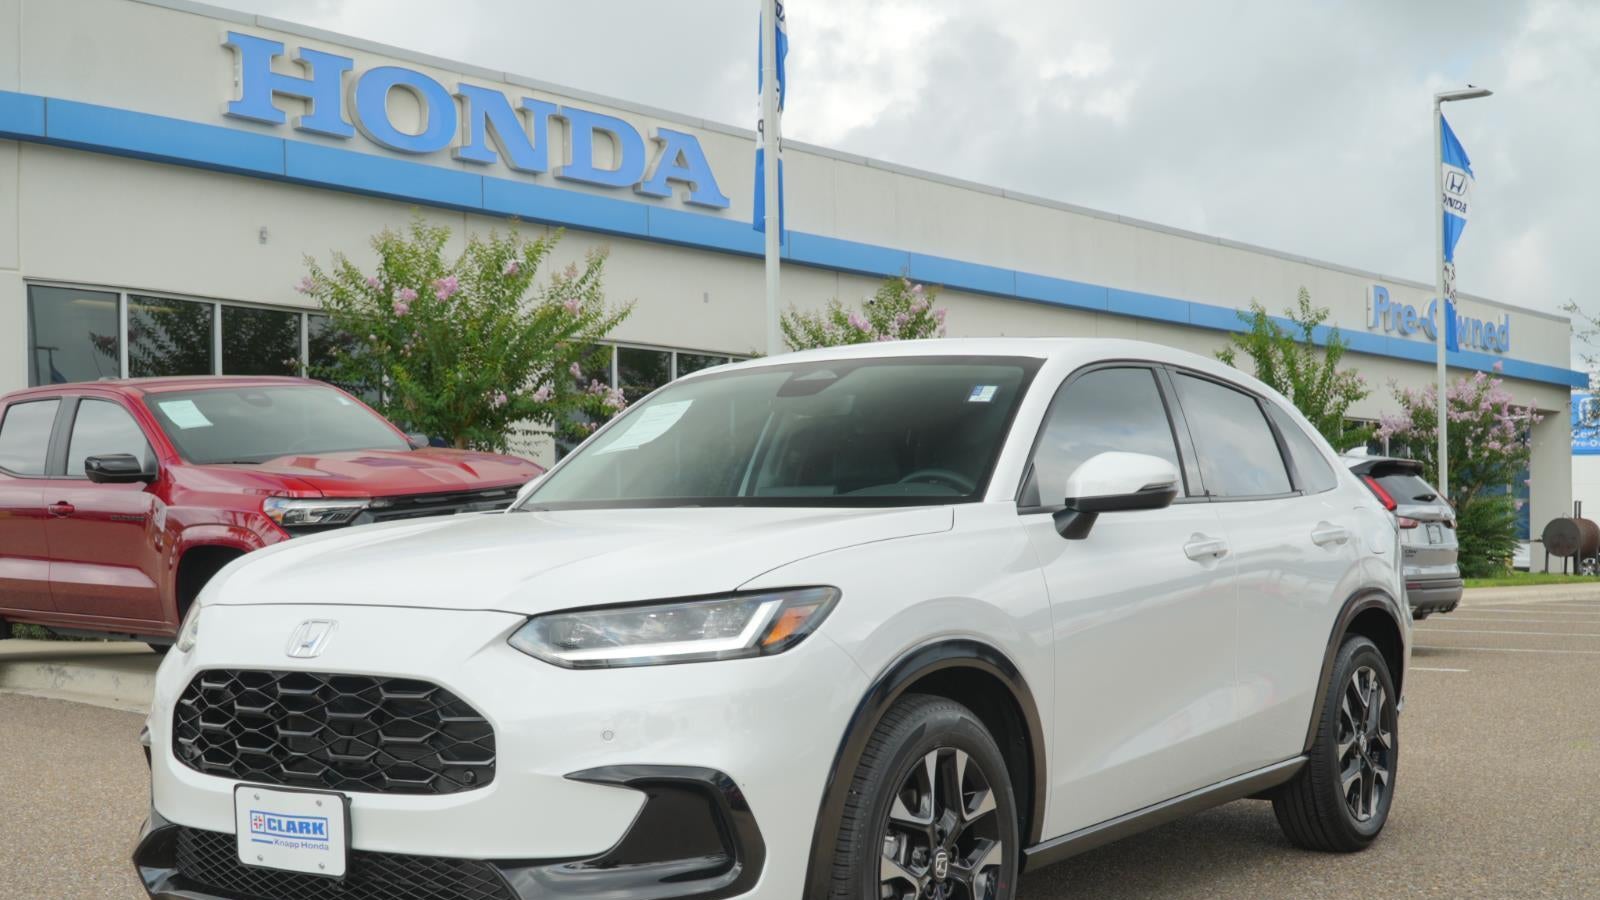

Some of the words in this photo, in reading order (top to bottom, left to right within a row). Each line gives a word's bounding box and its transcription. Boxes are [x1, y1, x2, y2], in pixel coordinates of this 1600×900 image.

[222, 31, 730, 209] HONDA
[267, 817, 325, 836] CLARK
[273, 839, 300, 849] Knapp
[301, 841, 329, 851] Honda
